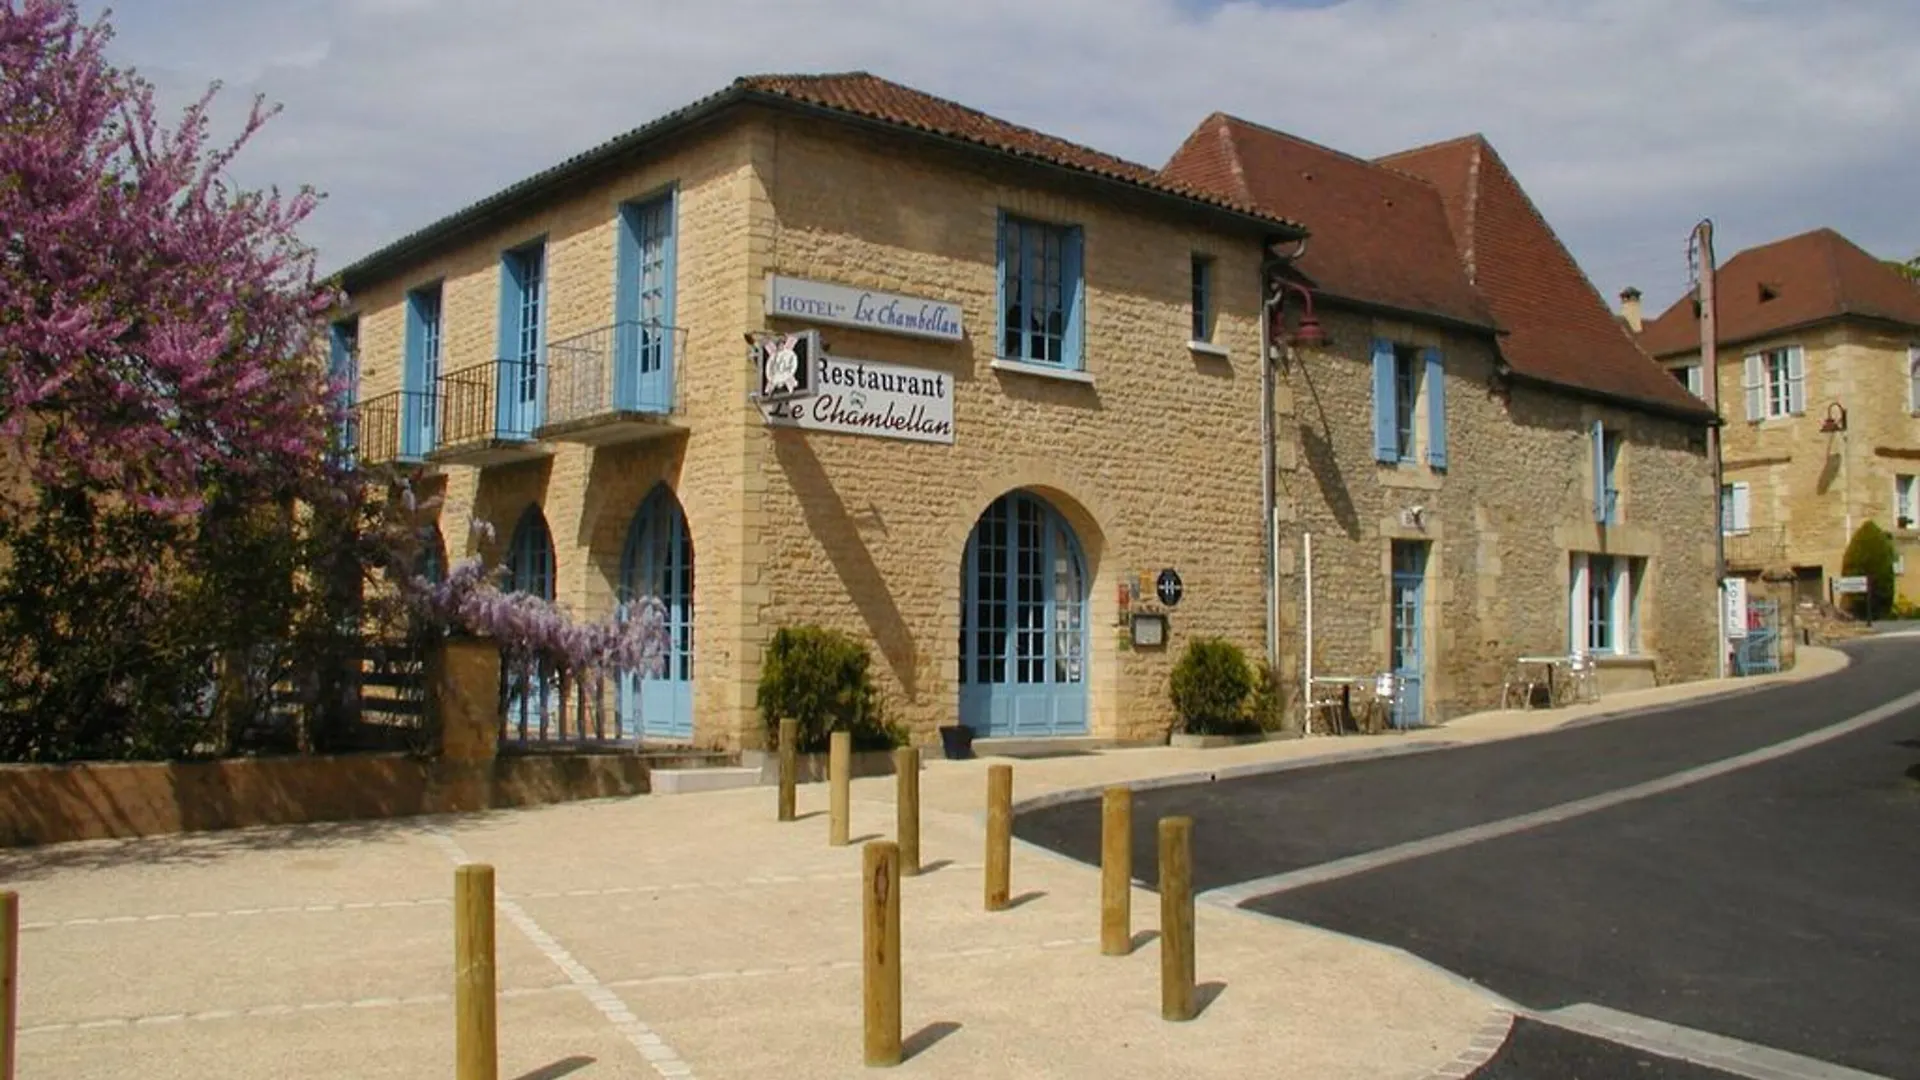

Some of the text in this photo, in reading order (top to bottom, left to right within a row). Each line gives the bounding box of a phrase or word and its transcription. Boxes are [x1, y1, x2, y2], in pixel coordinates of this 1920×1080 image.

[854, 292, 875, 322] Le
[877, 299, 959, 334] Chambellan
[819, 357, 946, 398] Restaurant
[812, 394, 951, 436] Chambellan
